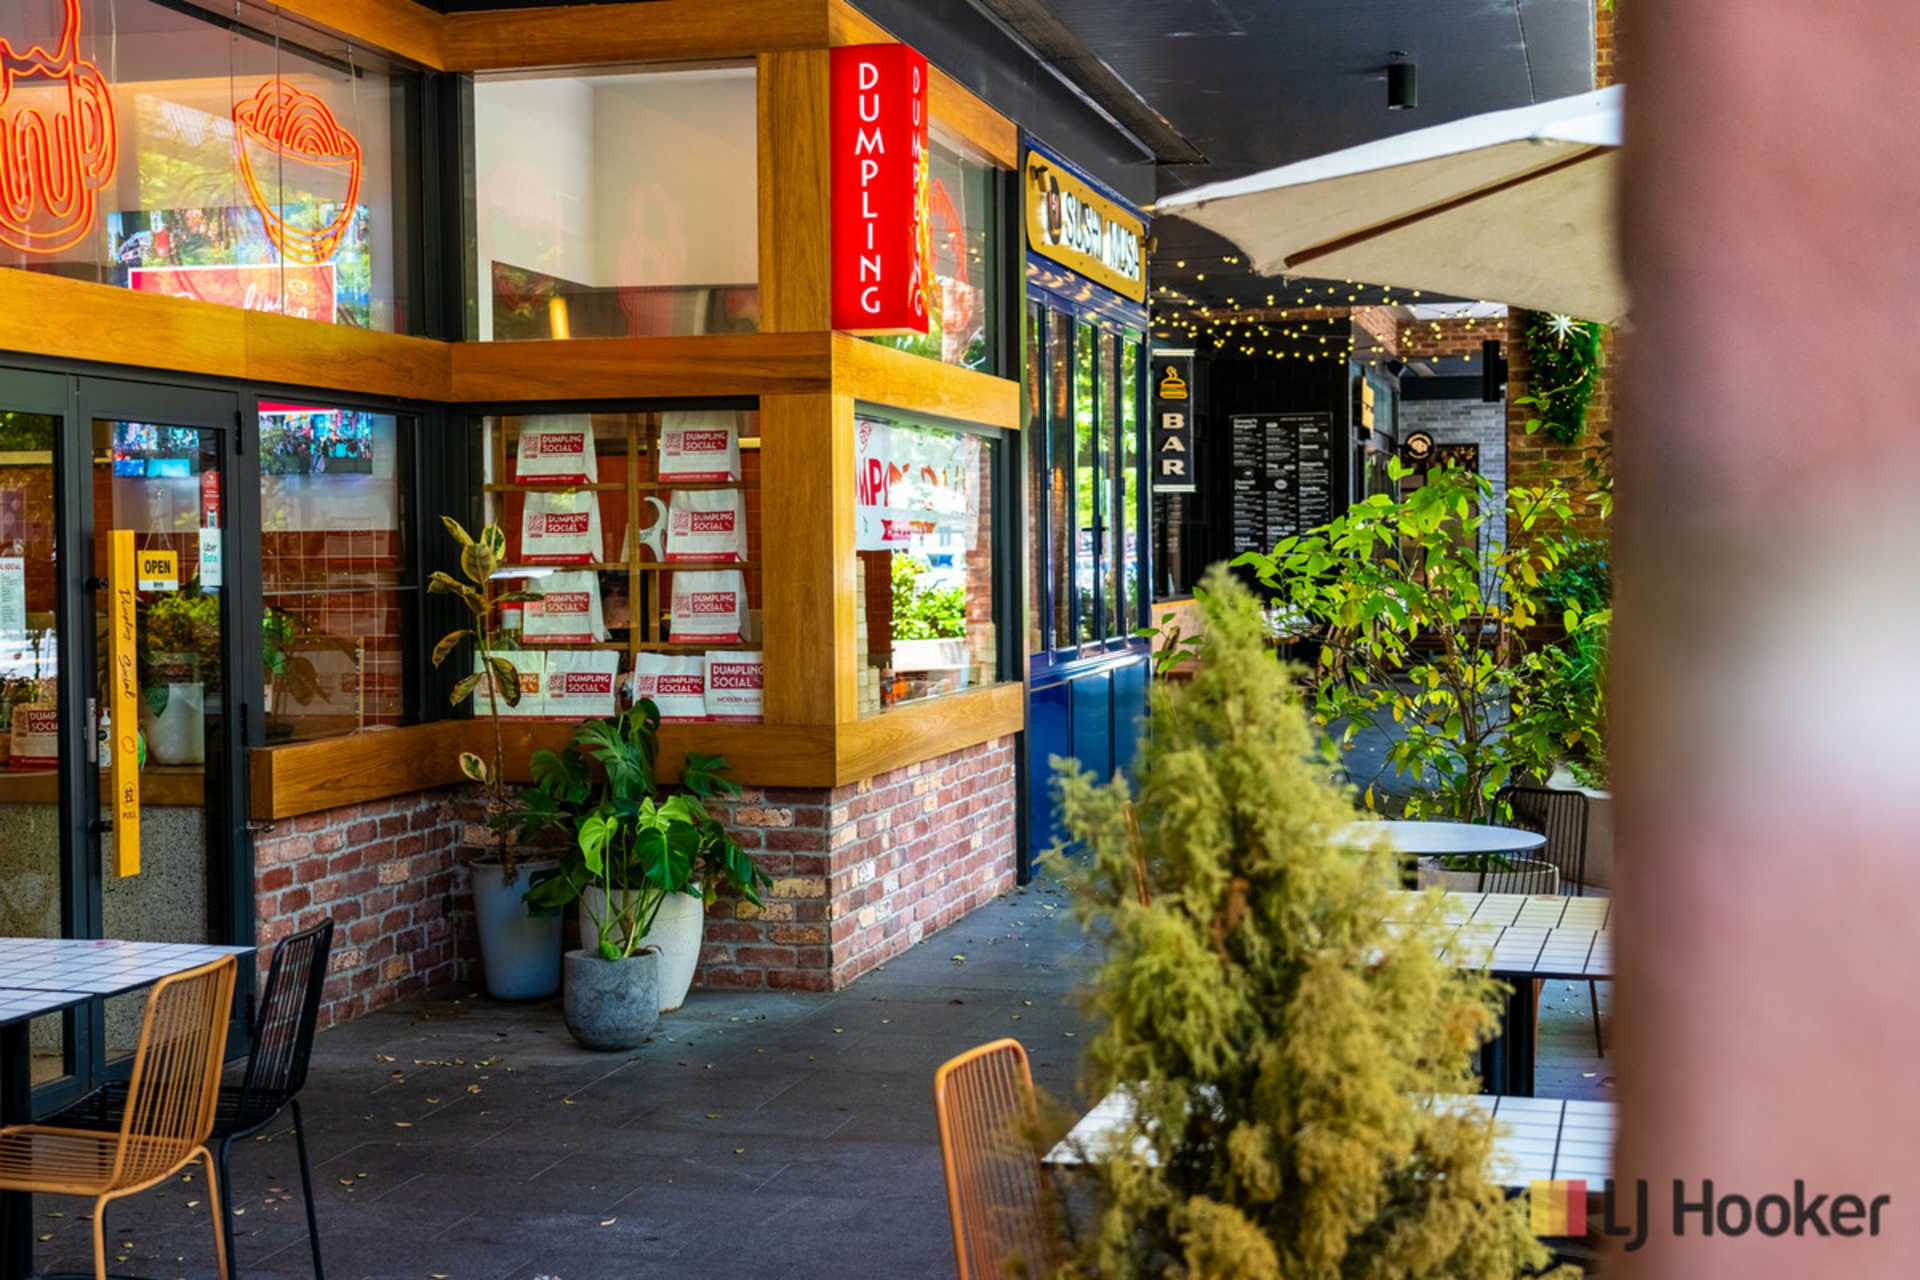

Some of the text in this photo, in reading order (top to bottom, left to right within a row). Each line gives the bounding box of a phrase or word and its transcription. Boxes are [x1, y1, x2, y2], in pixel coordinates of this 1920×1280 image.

[854, 62, 885, 313] DUMPLING
[542, 434, 582, 443] DUMPLING
[542, 444, 574, 452] SOCIAL
[685, 441, 717, 450] SOCIAL
[1161, 412, 1186, 476] BAR
[548, 513, 587, 523] DUMPLING
[693, 512, 733, 521] DUMPLING
[548, 524, 579, 532] SOCIAL
[693, 521, 724, 531] SOCIAL
[203, 543, 217, 552] Uber
[203, 553, 218, 563] Eats
[144, 560, 171, 574] OPEN
[546, 594, 588, 603] DUMPLING
[693, 594, 733, 603] DUMPLING
[547, 603, 579, 612] SOCIAL
[694, 603, 725, 612] SOCIAL
[712, 665, 763, 675] DUMPLING
[568, 674, 609, 683] DUMPLING
[713, 677, 753, 687] SOCIAL
[568, 683, 599, 692] SOCIAL
